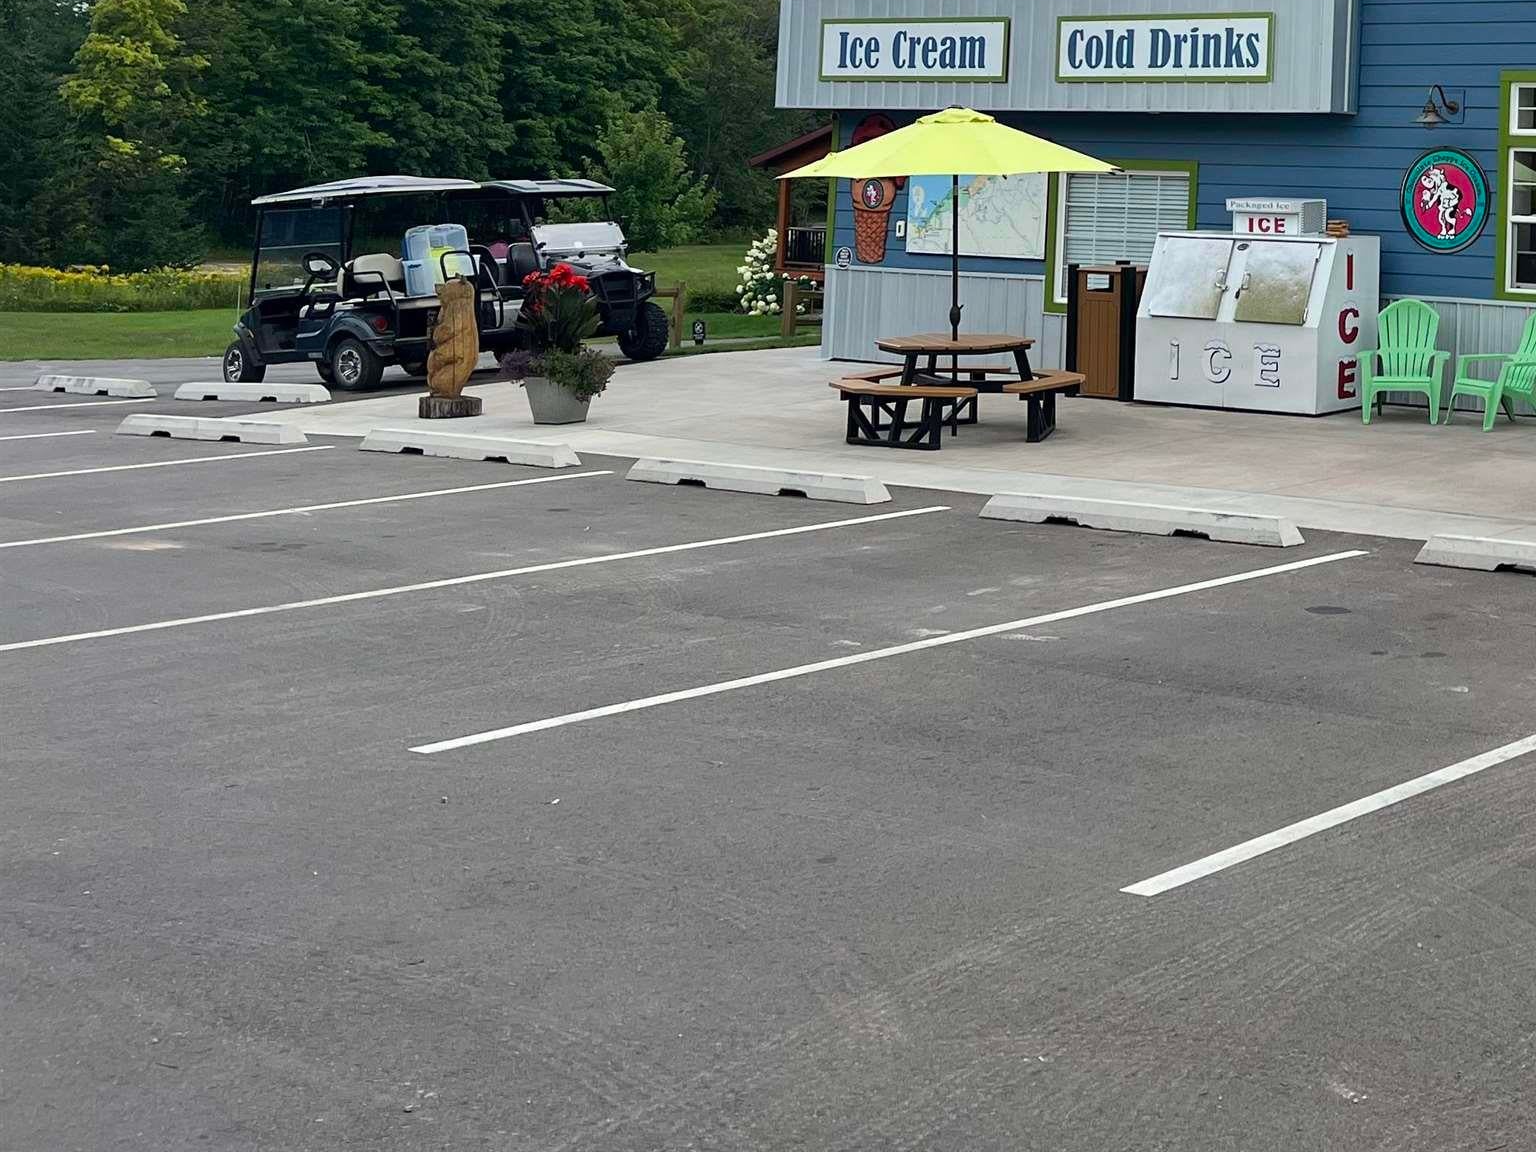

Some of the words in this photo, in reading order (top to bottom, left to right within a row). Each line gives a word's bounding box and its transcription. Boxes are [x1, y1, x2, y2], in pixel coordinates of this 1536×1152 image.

[837, 31, 880, 69] Ice
[892, 30, 986, 69] Cream
[1067, 28, 1135, 69] Cold
[1148, 27, 1260, 69] Drinks
[1248, 217, 1286, 233] ICE
[1337, 248, 1360, 399] ICE
[1169, 337, 1281, 388] ICE
